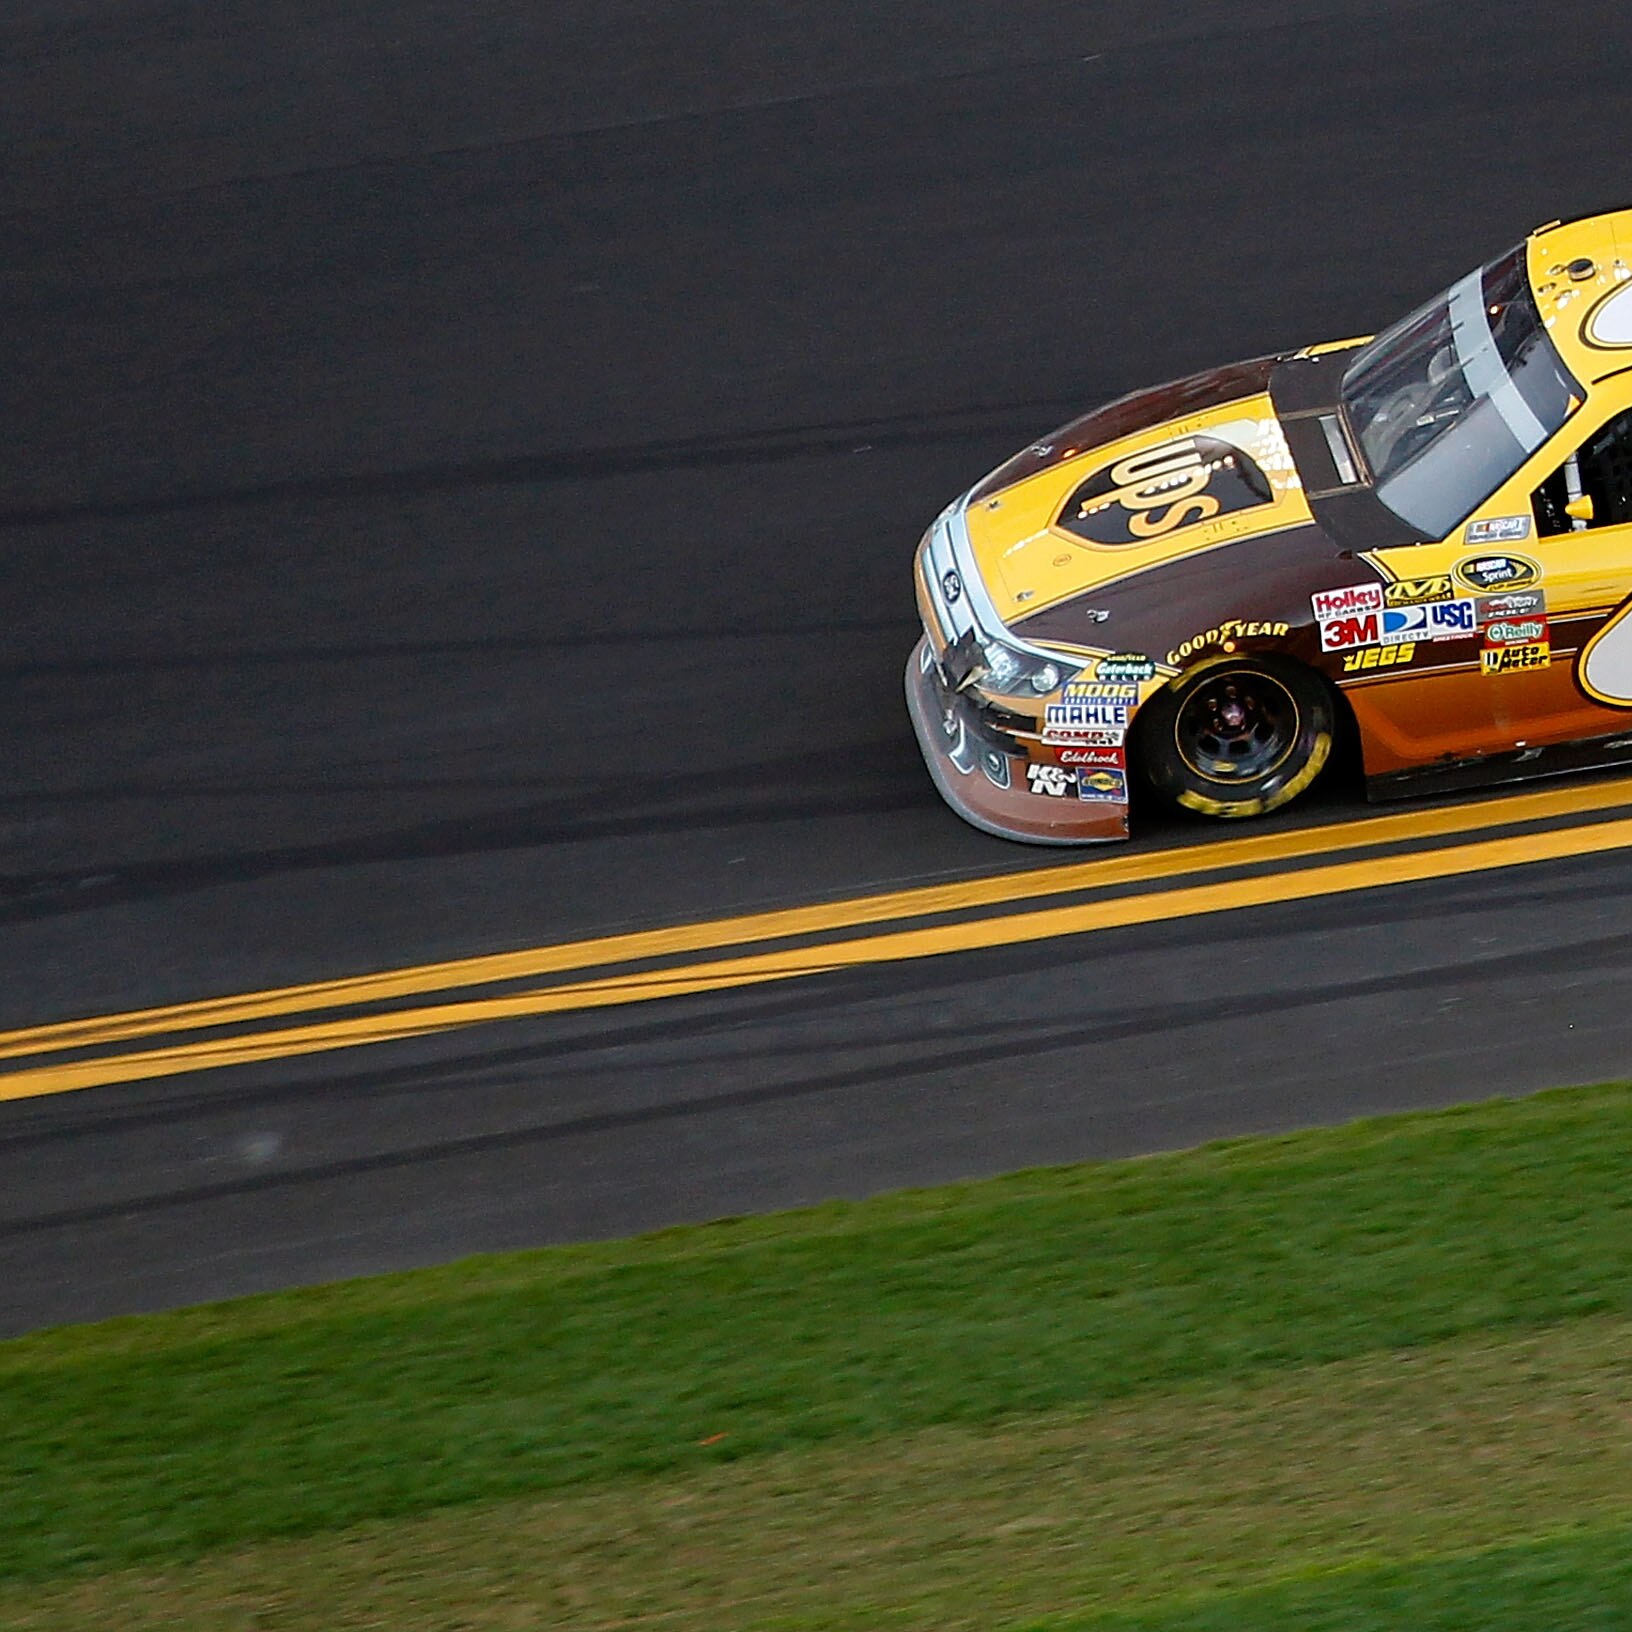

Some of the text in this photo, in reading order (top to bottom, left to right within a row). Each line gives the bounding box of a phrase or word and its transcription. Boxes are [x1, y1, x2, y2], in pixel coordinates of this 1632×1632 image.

[1482, 568, 1513, 582] Sprint
[1316, 589, 1381, 613] Holley
[1431, 601, 1474, 630] USG
[1324, 614, 1379, 647] 3M
[1383, 631, 1429, 644] DIRECTV
[1167, 618, 1290, 665] GOODYEAR
[1343, 642, 1416, 672] JEGS
[1503, 646, 1539, 659] Auto
[1064, 683, 1136, 698] MOOG
[1048, 705, 1126, 724] MAHLE
[1060, 750, 1119, 765] Edelbrock
